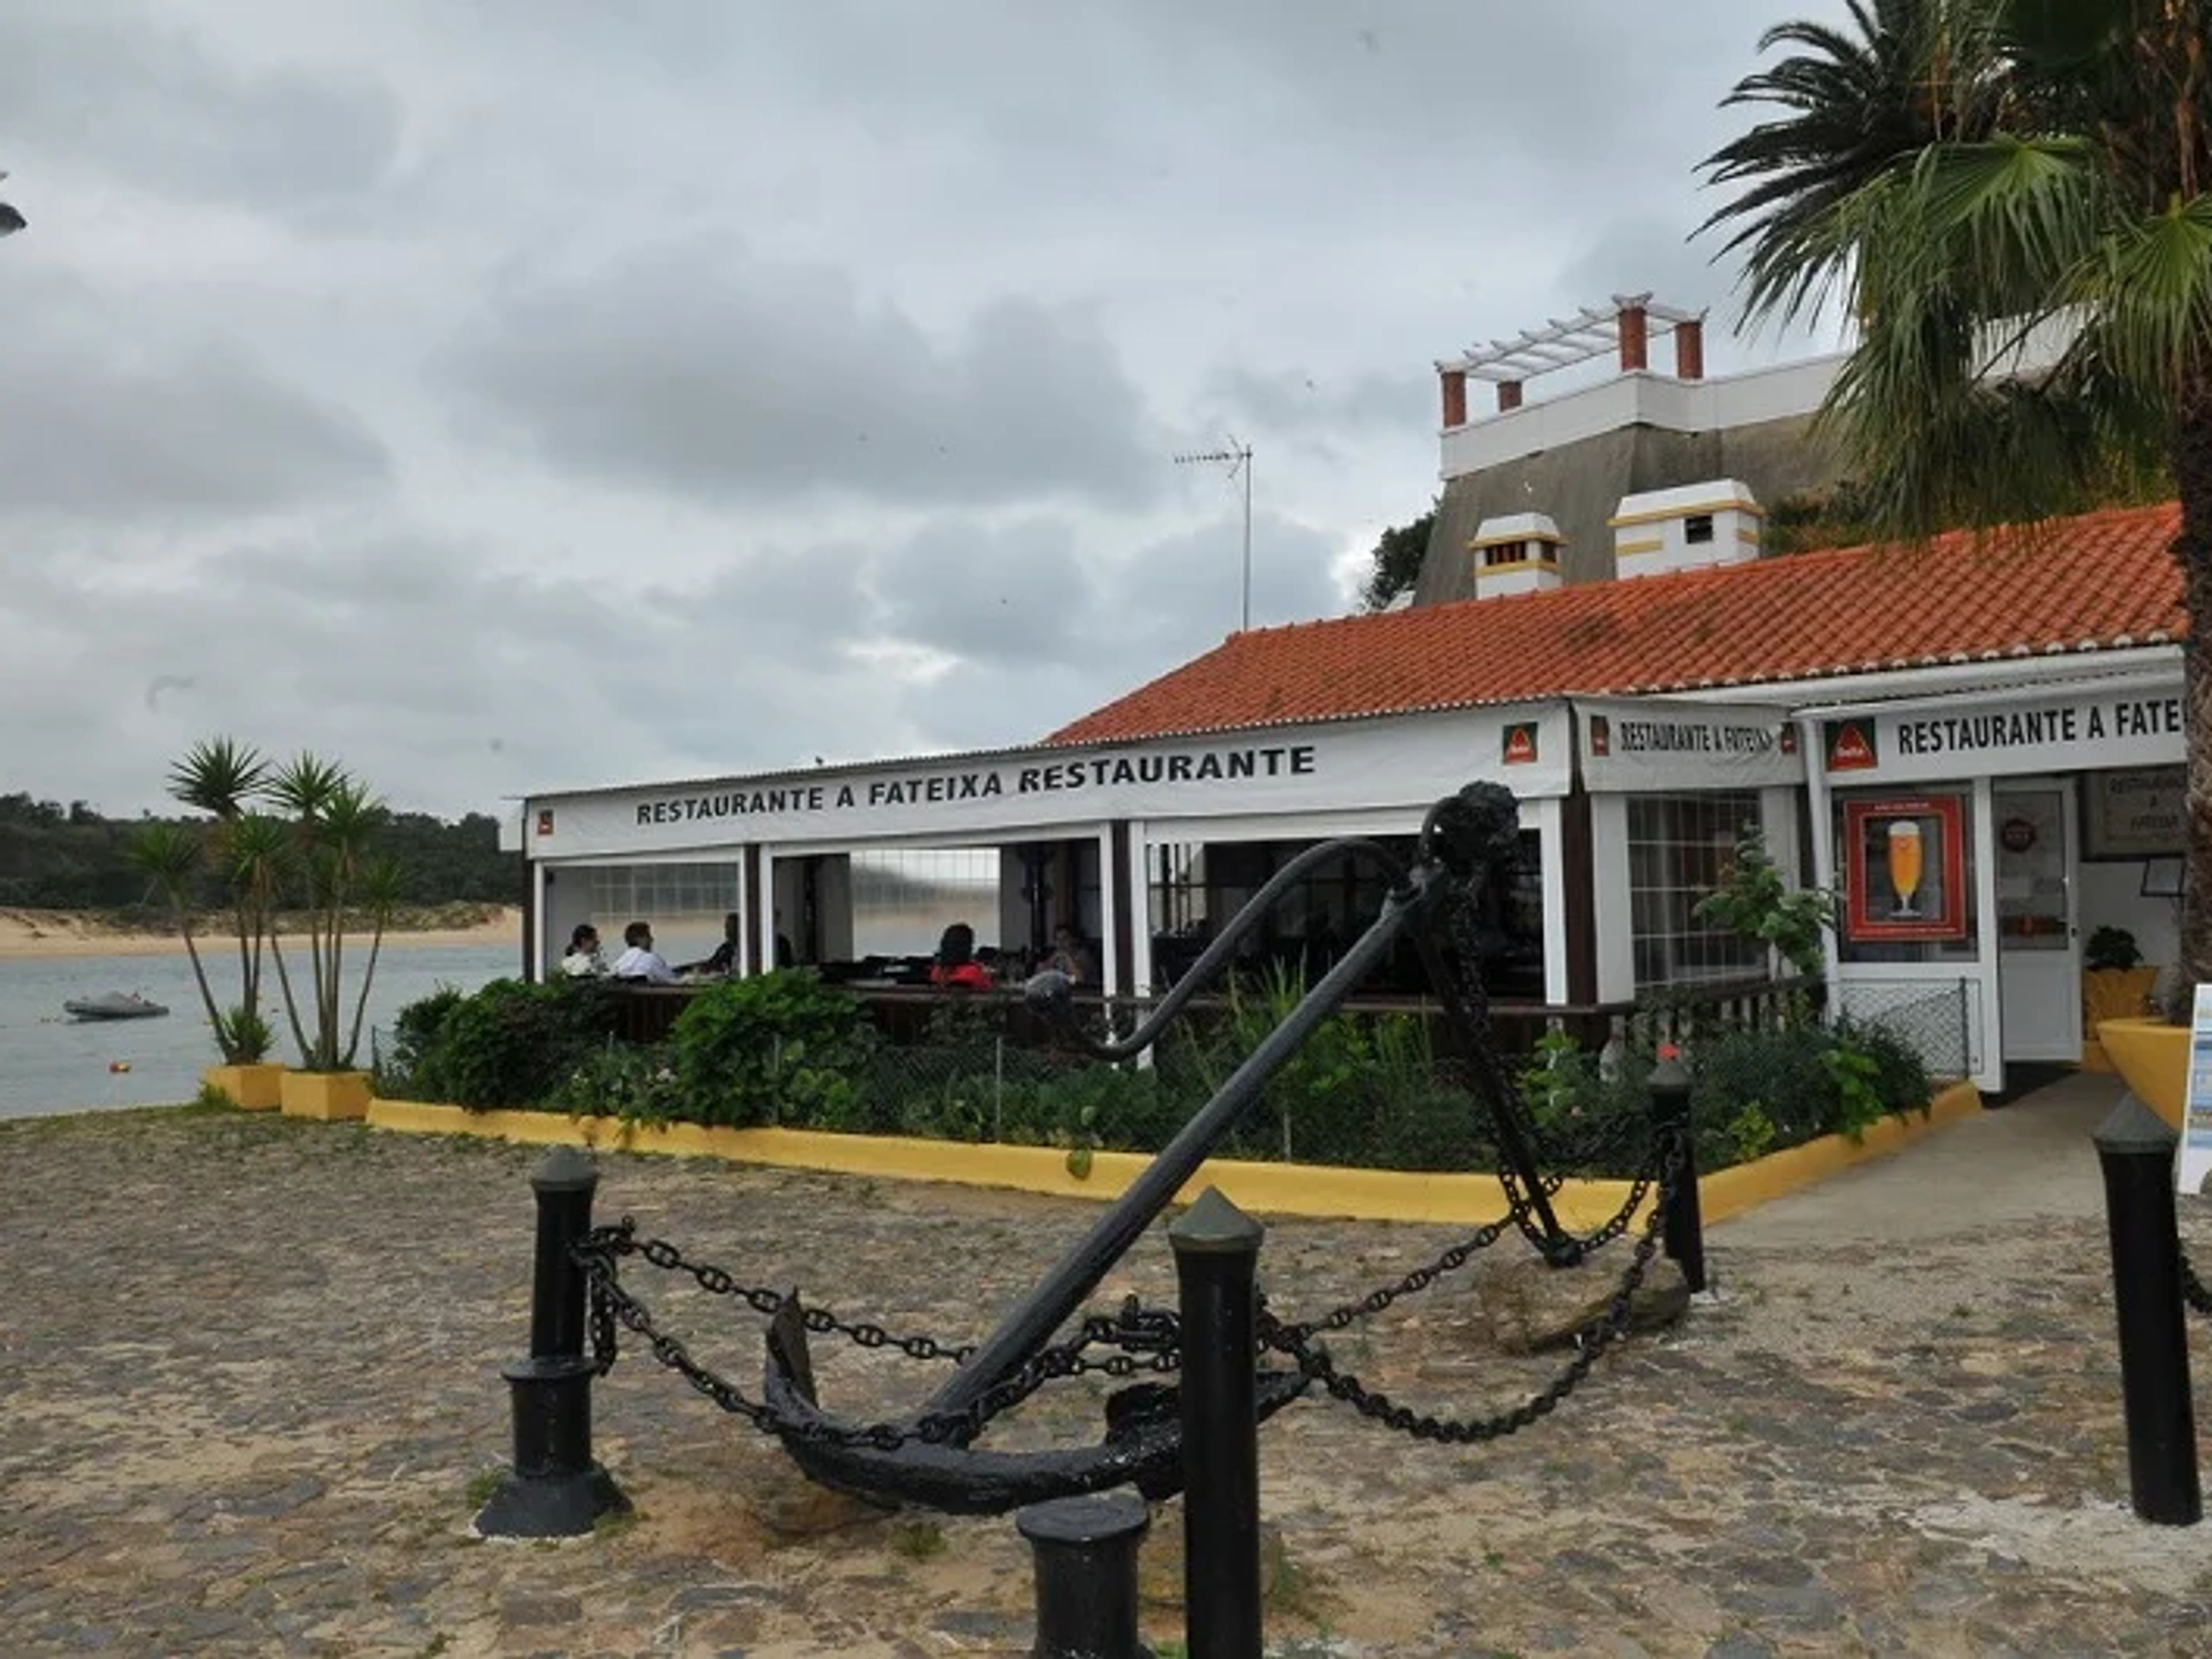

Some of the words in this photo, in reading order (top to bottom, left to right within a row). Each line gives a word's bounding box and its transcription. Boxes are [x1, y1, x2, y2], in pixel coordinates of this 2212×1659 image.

[1620, 721, 1710, 751] RESTAURANTE
[1897, 706, 2077, 754] RESTAURANTE
[2088, 705, 2105, 738] A
[637, 786, 825, 825] RESTAURANTE
[836, 785, 855, 808] A
[869, 772, 1002, 805] FATEIXA
[1018, 745, 1316, 793] RESTAURANTE
